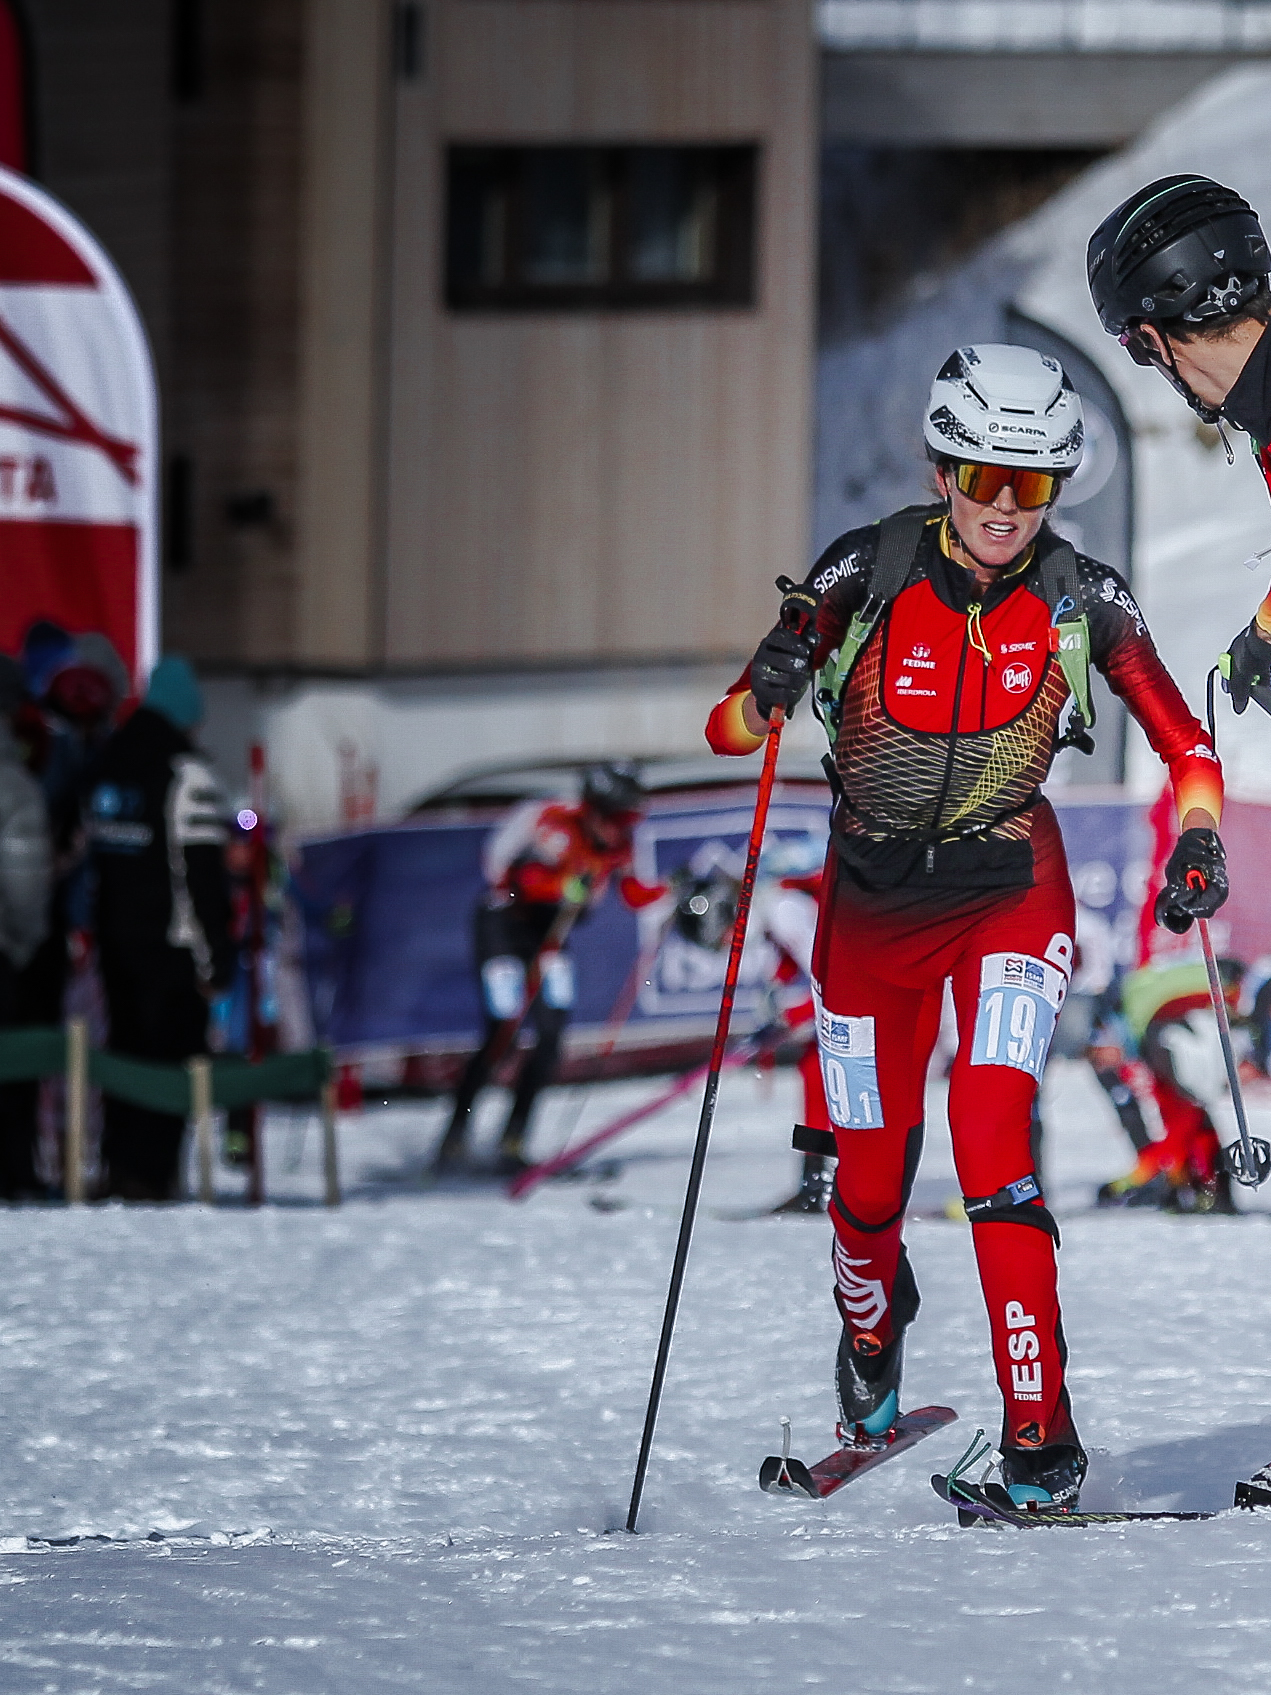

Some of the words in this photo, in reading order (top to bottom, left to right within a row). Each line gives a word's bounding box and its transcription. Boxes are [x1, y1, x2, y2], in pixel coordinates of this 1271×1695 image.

[1001, 425, 1047, 438] SCARPA
[813, 552, 860, 594] SISMIC
[1113, 590, 1147, 636] SISMIC
[1009, 641, 1037, 653] SISMIC
[902, 658, 937, 670] FEDME
[896, 688, 937, 697] IBERDROLA
[983, 991, 1046, 1074] 19.1
[819, 1049, 874, 1125] 9.1
[1006, 1300, 1043, 1393] ESP
[1013, 1392, 1043, 1402] FEDME
